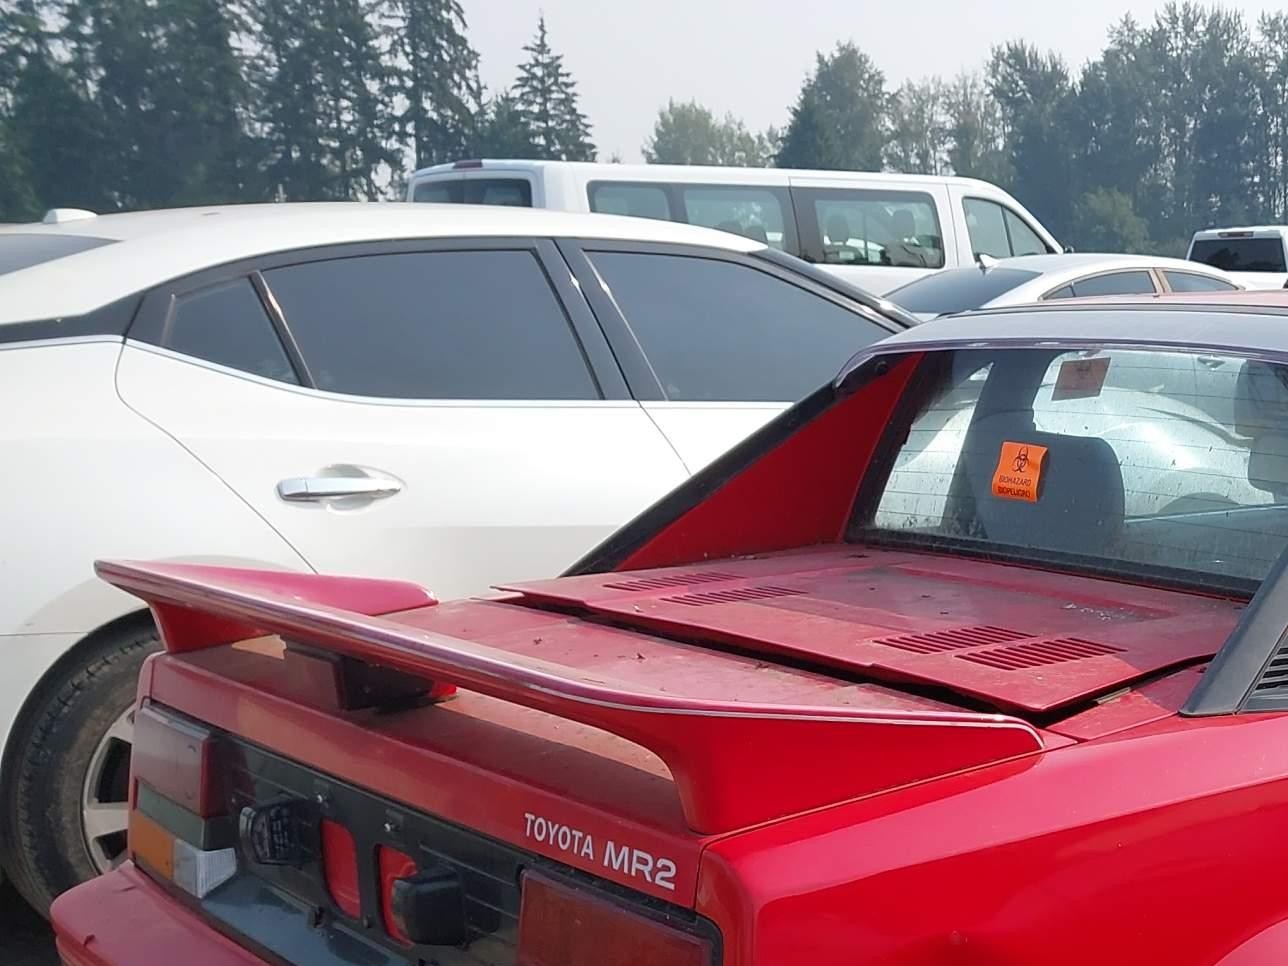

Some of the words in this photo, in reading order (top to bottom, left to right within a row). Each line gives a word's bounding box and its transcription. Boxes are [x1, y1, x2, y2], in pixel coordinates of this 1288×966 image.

[998, 474, 1032, 487] BIOHAZARD
[524, 812, 595, 861] TOYOTA
[603, 840, 677, 891] MR2
